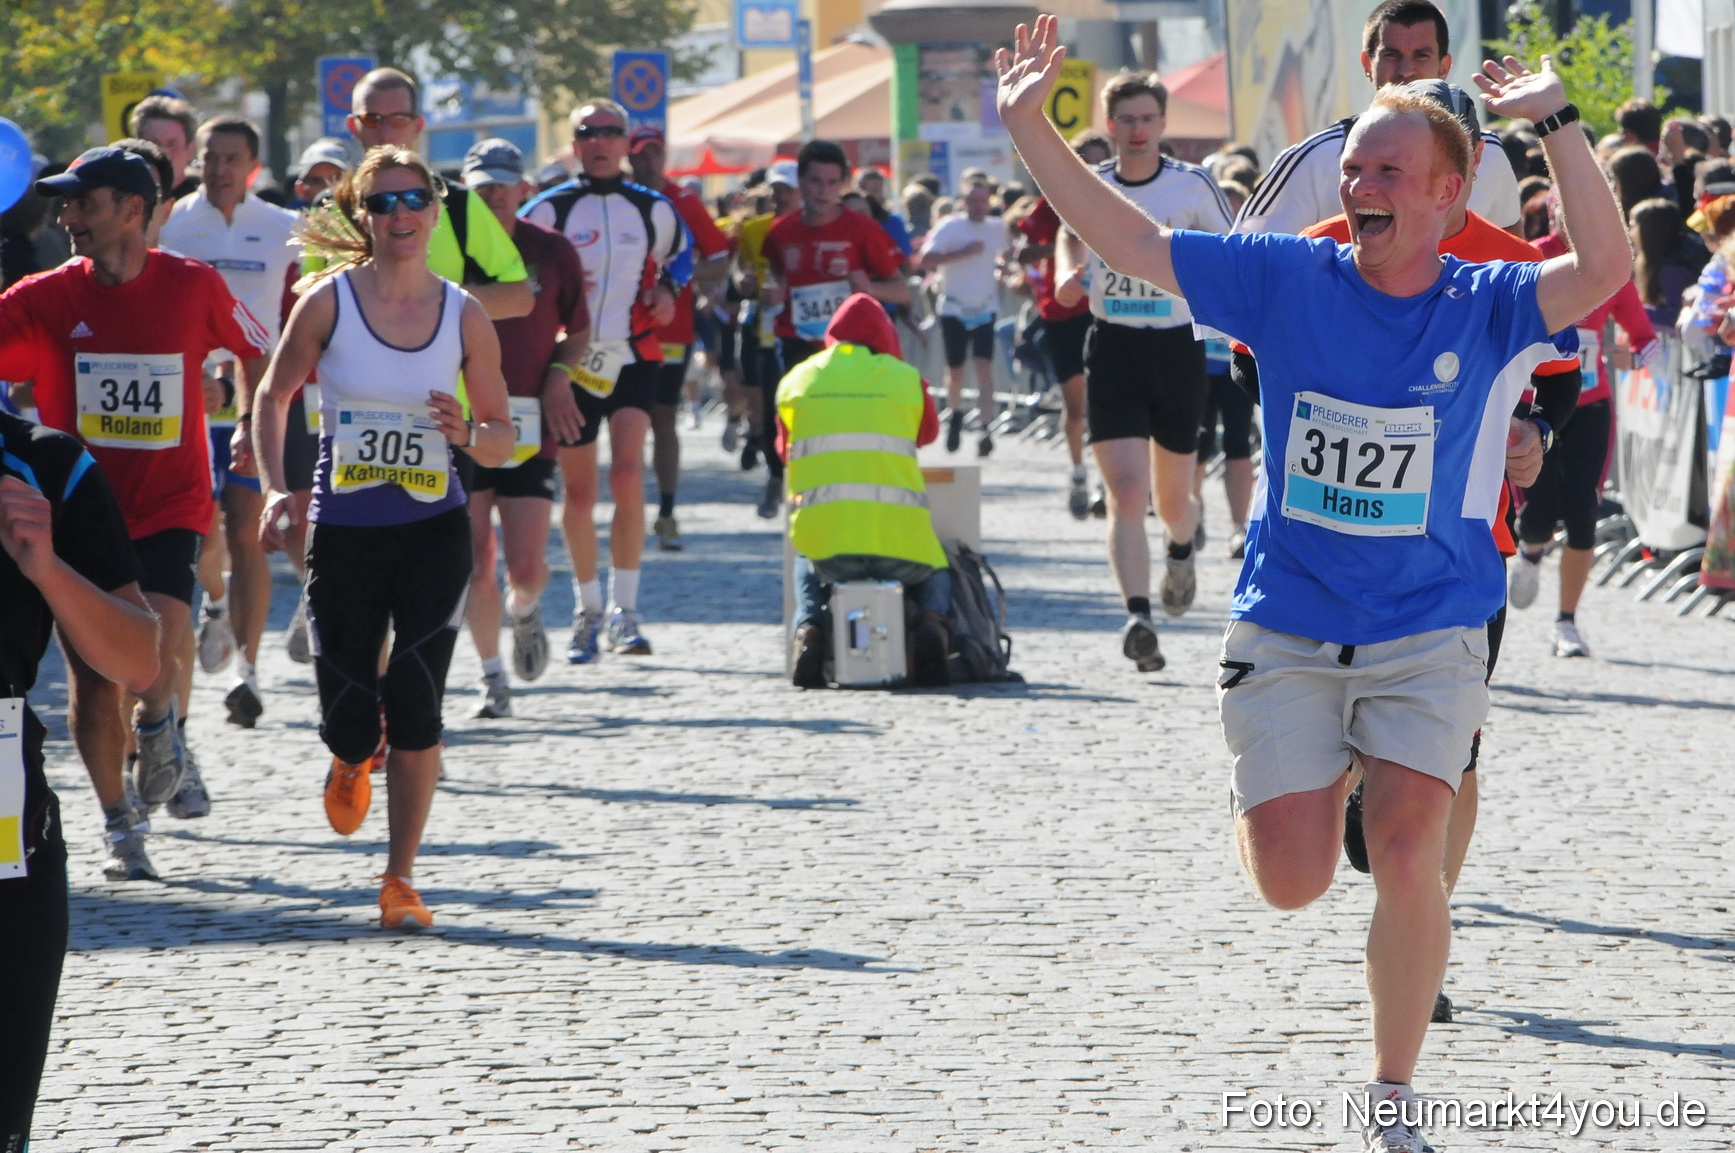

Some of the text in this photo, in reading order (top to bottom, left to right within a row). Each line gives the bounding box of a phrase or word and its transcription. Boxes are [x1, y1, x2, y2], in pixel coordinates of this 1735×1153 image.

[1052, 86, 1079, 129] C
[1112, 300, 1156, 313] Daniel
[100, 379, 163, 413] 344
[101, 415, 163, 436] Roland
[1312, 404, 1368, 429] PFLEIDERER
[358, 429, 424, 466] 305
[1301, 428, 1416, 489] 3127
[344, 465, 436, 488] Katharina
[1322, 485, 1384, 519] Hans
